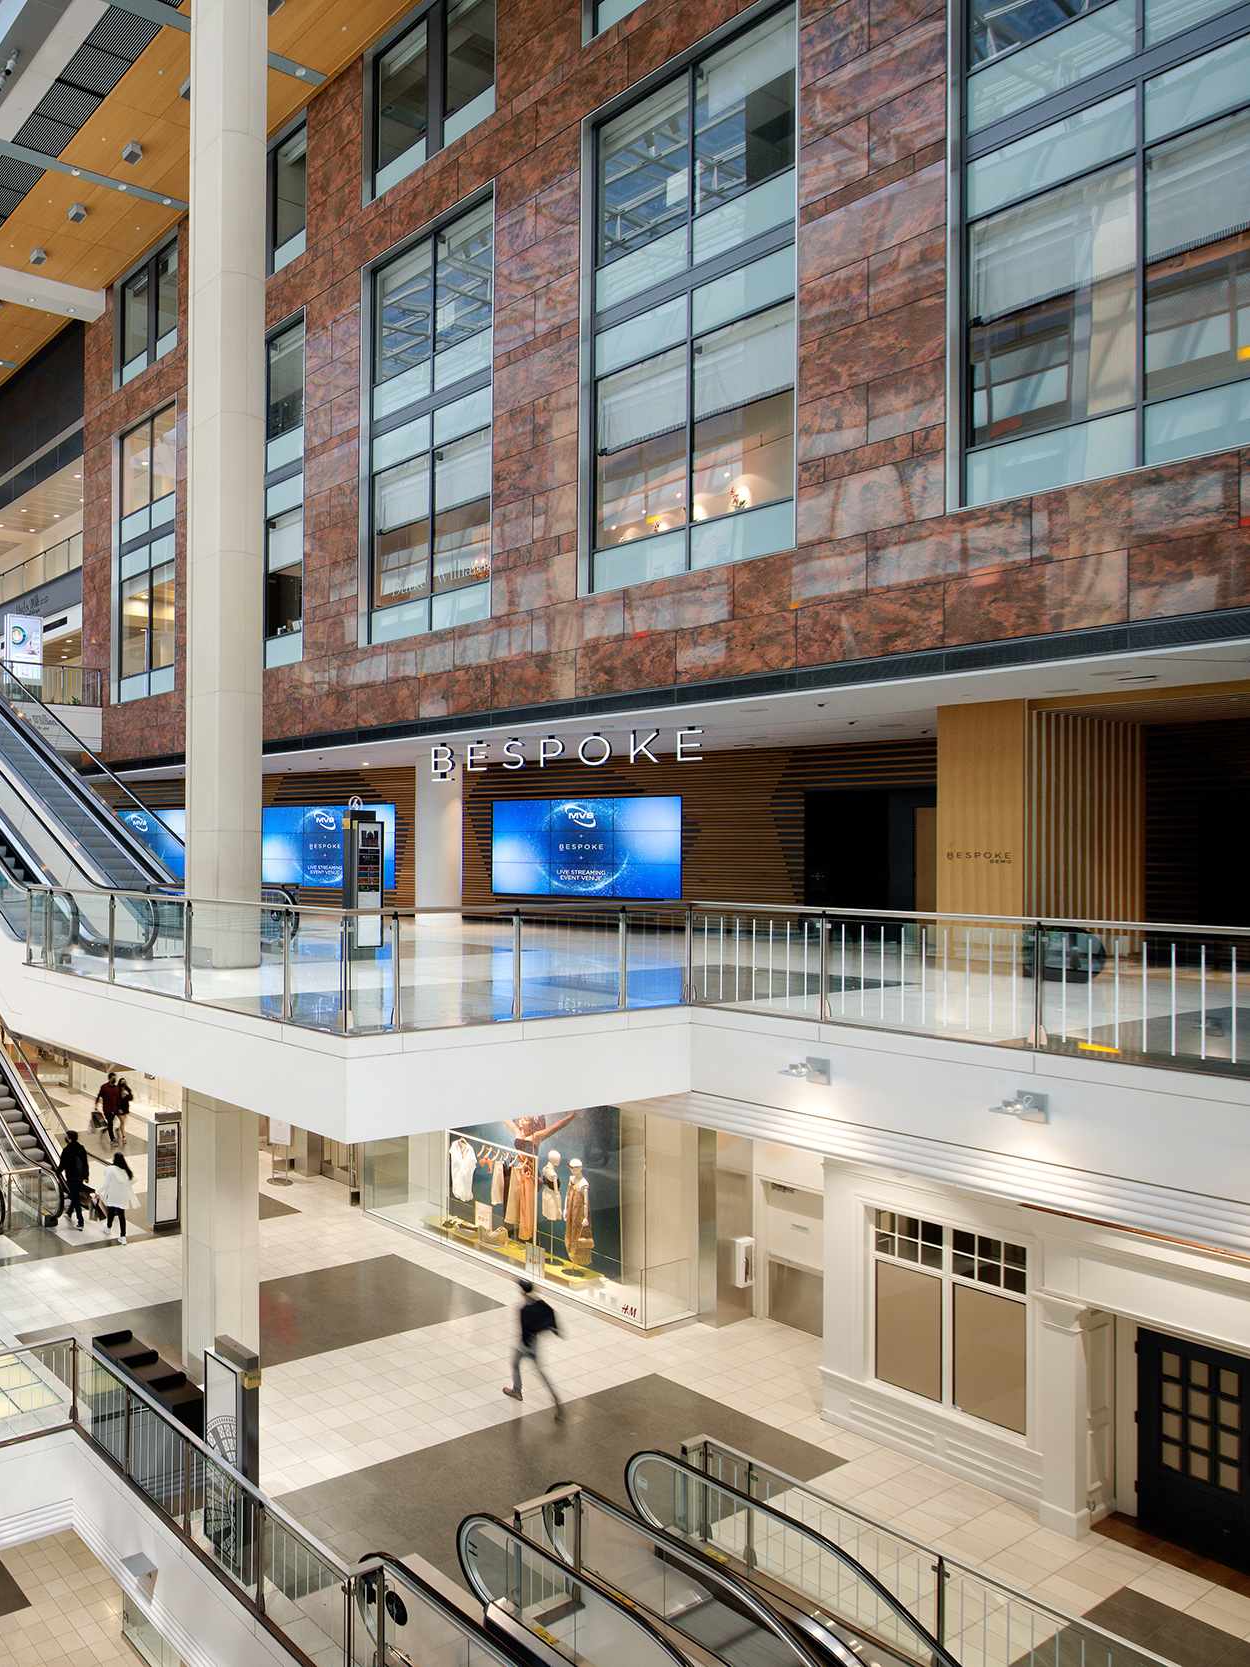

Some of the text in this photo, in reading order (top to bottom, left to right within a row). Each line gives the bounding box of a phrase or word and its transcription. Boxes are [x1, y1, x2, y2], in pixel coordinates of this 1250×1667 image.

[391, 571, 427, 597] Burke
[431, 730, 705, 782] BESPOKE
[559, 843, 604, 852] BESPOKE
[946, 851, 1012, 860] BESPOKE
